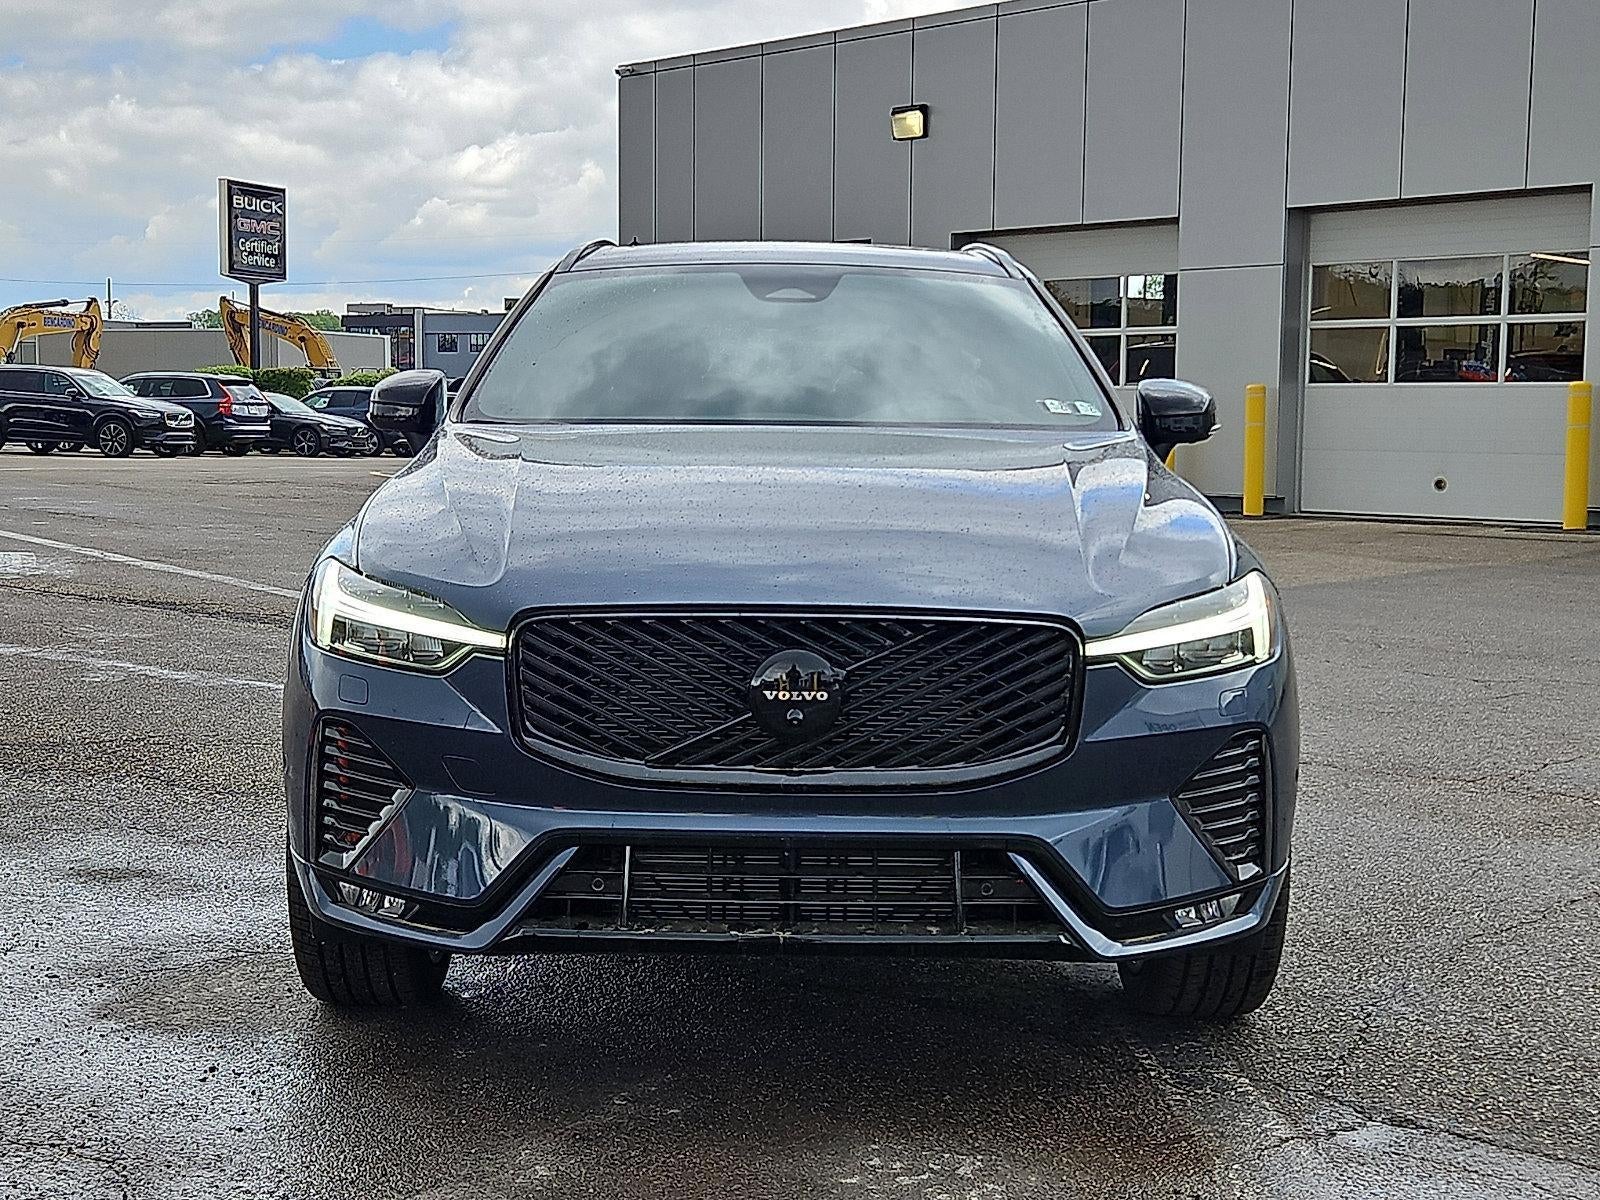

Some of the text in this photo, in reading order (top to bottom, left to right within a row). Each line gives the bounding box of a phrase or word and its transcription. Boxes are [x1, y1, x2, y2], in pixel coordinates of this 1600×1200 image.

[232, 195, 283, 215] BUICK
[236, 217, 281, 236] GMC
[238, 238, 279, 255] Certified
[240, 252, 276, 268] Service
[762, 690, 829, 701] VOLVO
